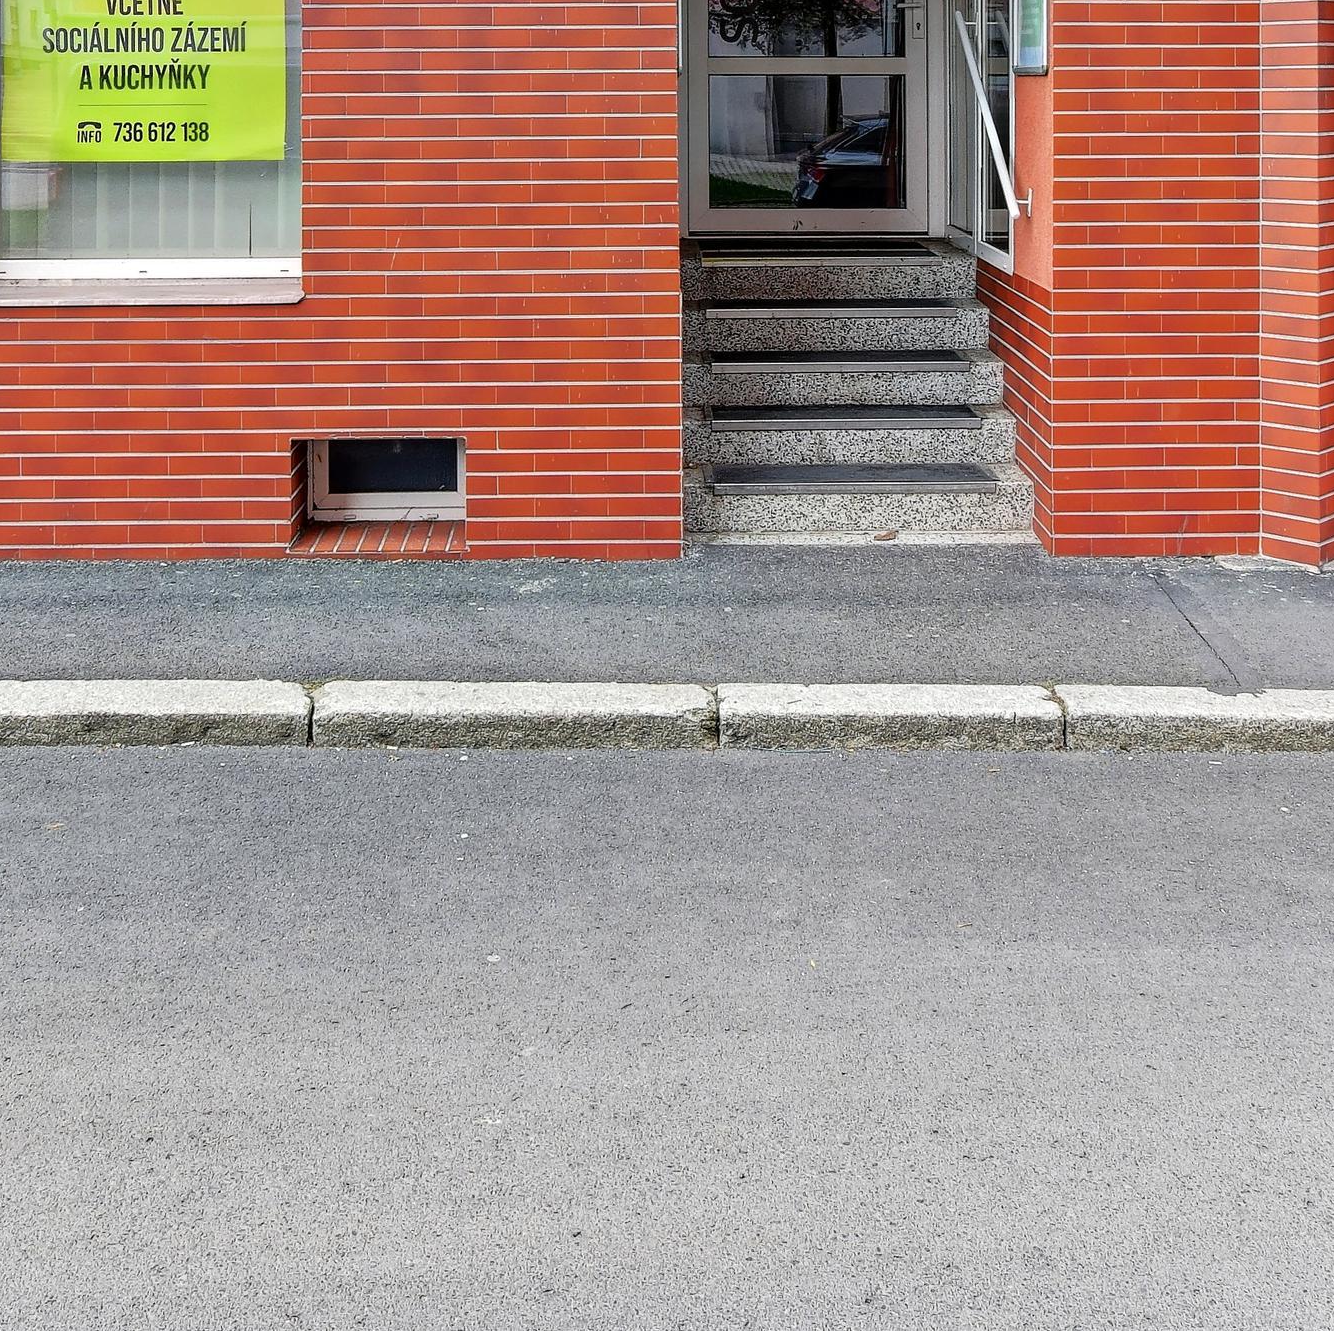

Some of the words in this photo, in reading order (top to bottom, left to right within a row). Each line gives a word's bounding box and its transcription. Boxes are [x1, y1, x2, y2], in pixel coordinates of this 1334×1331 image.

[42, 21, 165, 54] SOCIÁLNÍHO
[170, 21, 248, 53] ZÁZEMÍ
[78, 65, 93, 90] A
[99, 58, 211, 90] KUCHYŇKY
[77, 130, 102, 144] INFO
[113, 122, 143, 142] 736
[148, 122, 176, 142] 612
[181, 122, 209, 142] 138
